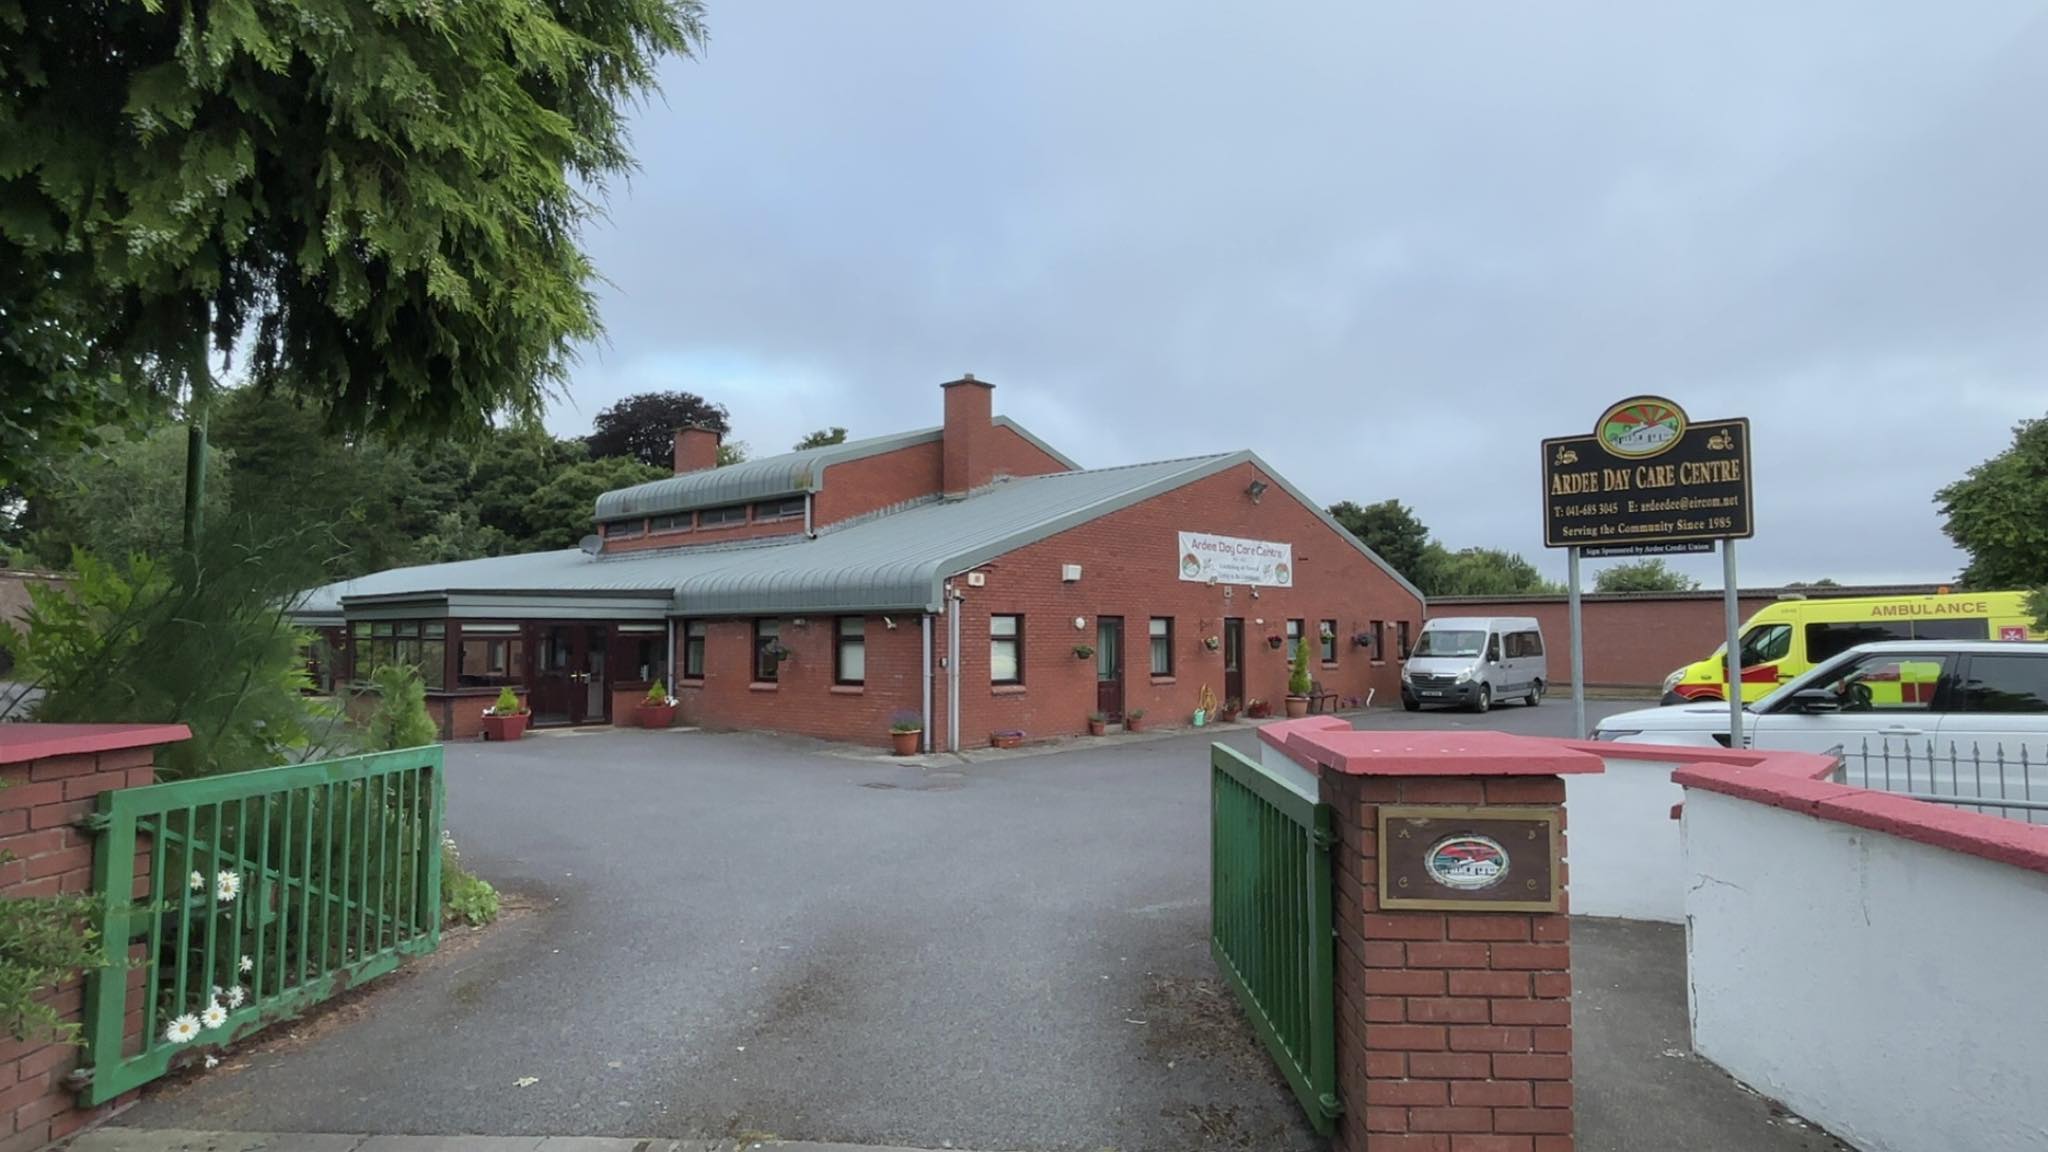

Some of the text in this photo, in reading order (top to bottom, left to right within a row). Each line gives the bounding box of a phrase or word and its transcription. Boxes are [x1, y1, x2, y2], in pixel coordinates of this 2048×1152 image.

[1551, 459, 1740, 495] ARDEE DAY CARE CENTRE
[1554, 506, 1564, 517] T:
[1628, 501, 1638, 512] E:
[1562, 517, 1732, 537] Serving the Community Since 1985
[1191, 539, 1282, 559] Ardee Day Care Centre
[1871, 602, 1988, 617] AMBULANCE
